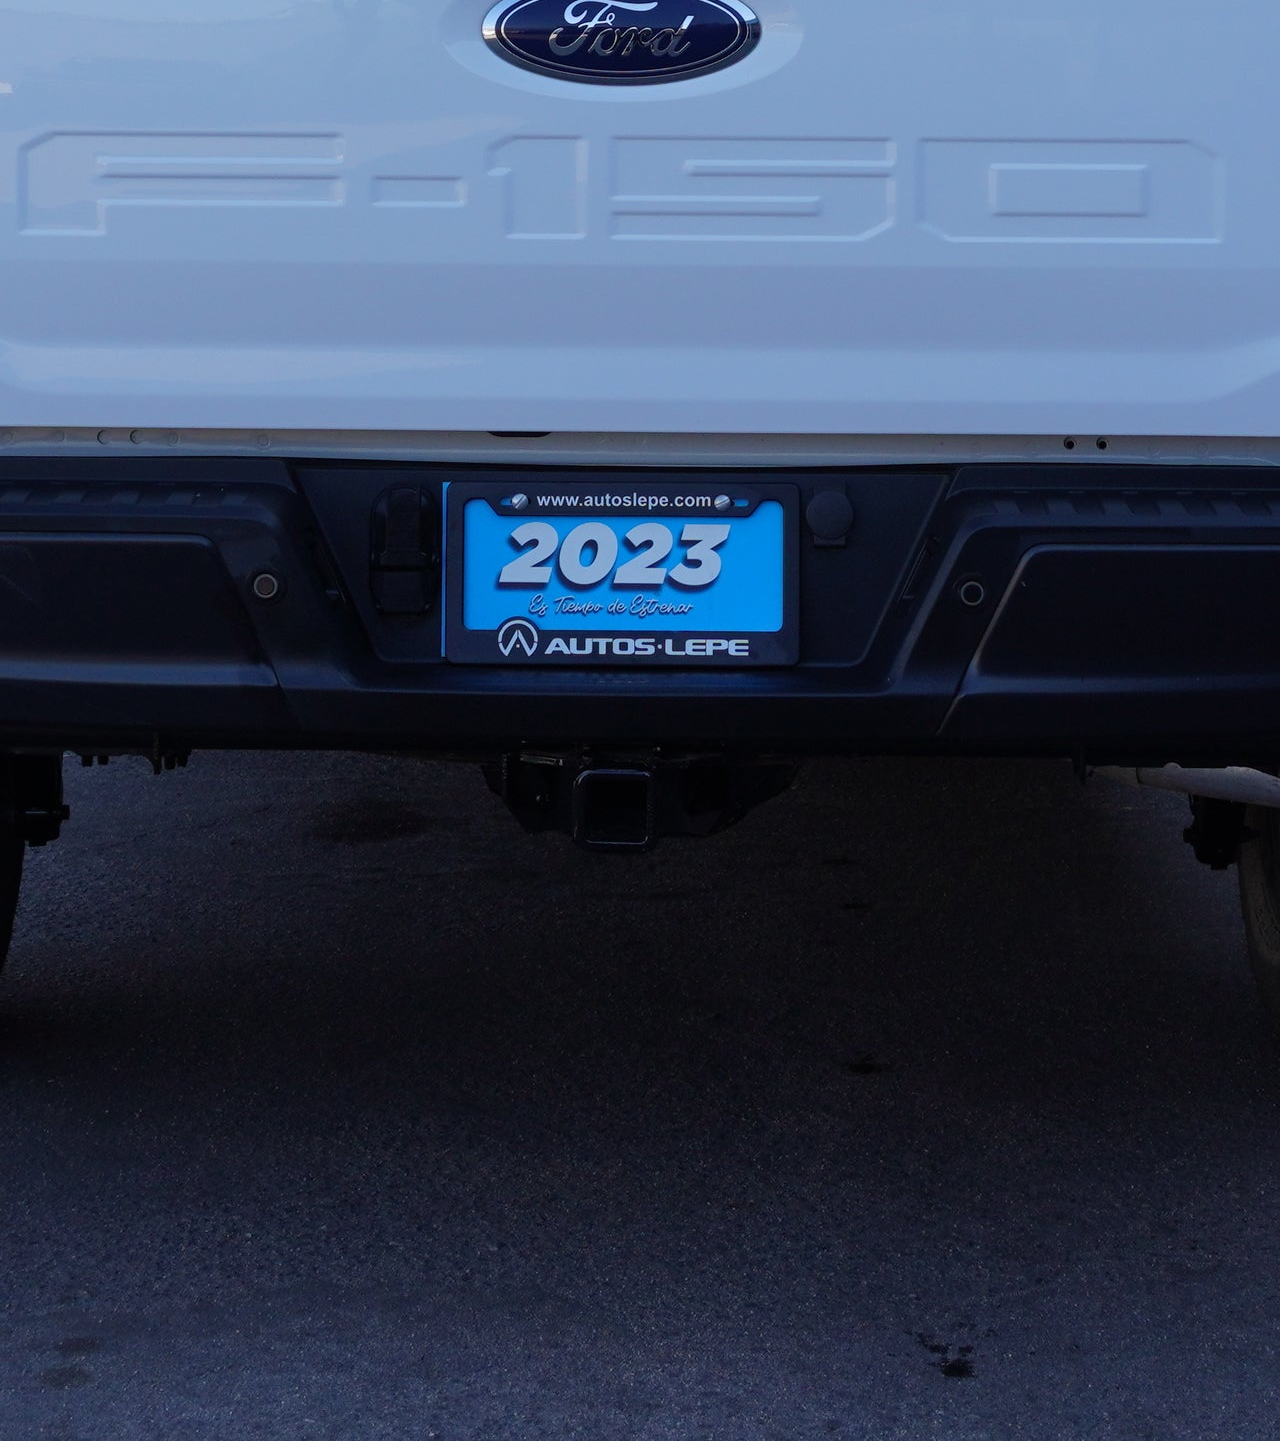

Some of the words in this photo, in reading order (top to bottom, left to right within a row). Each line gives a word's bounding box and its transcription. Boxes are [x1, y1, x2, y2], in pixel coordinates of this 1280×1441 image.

[17, 130, 1224, 244] F-150
[536, 493, 712, 510] www.autoslepe.com
[498, 521, 731, 587] 2023
[529, 594, 548, 616] Es
[553, 595, 604, 616] Tiempo
[607, 595, 627, 615] de
[628, 593, 694, 618] Estrenar
